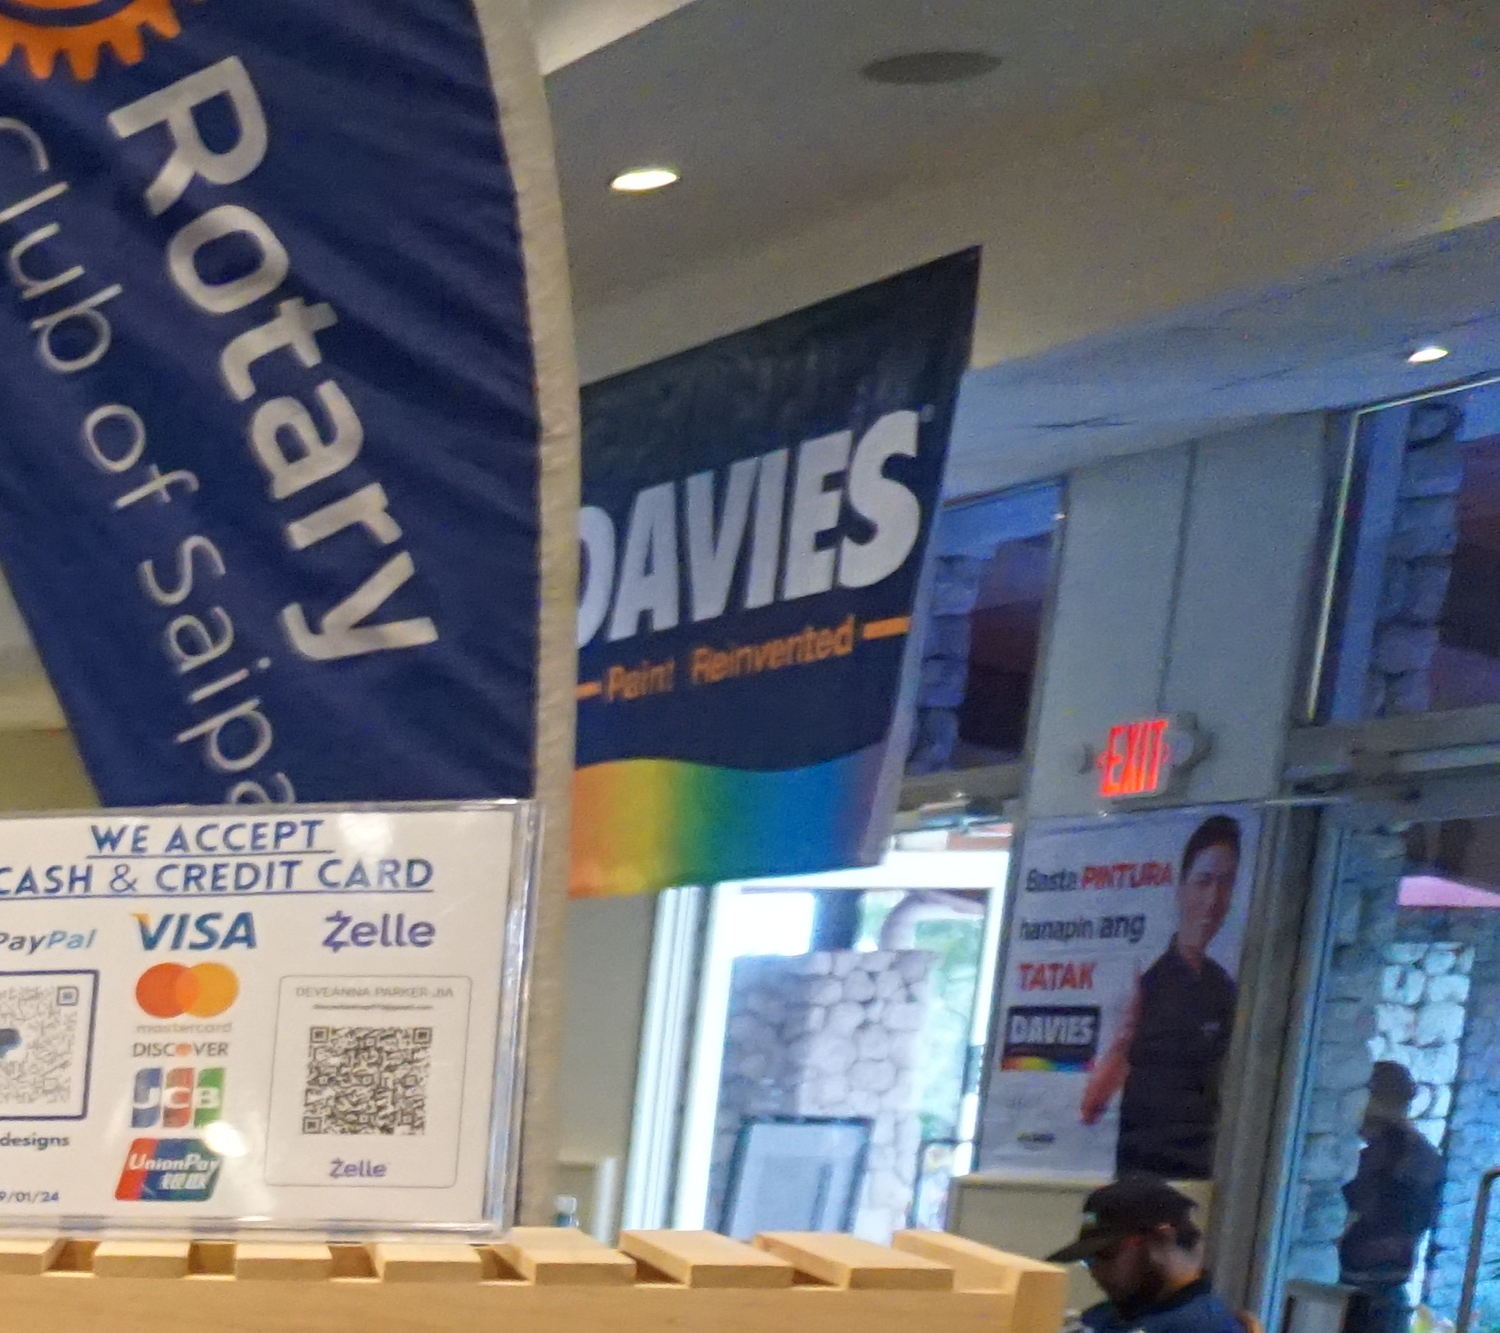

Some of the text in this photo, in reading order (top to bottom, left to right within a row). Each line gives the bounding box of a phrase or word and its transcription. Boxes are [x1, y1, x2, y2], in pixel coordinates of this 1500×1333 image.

[108, 56, 437, 660] Rotary
[84, 405, 199, 509] of
[608, 613, 854, 701] Paint Reinvented
[1101, 718, 1169, 797] EXIT
[91, 819, 326, 853] WE ACCEPT
[108, 863, 139, 892] &
[156, 858, 303, 892] CREDIT
[317, 857, 435, 889] CARD
[1080, 862, 1173, 889] PINTURA
[132, 911, 258, 951] VISA
[321, 910, 437, 952] Zelle
[1019, 913, 1146, 943] hanapin ang
[1017, 961, 1098, 991] TATAK
[1010, 1014, 1095, 1046] DAVIES
[132, 1042, 230, 1058] DISCOVER
[129, 1152, 222, 1172] UnionPay
[329, 1159, 388, 1180] Zelle
